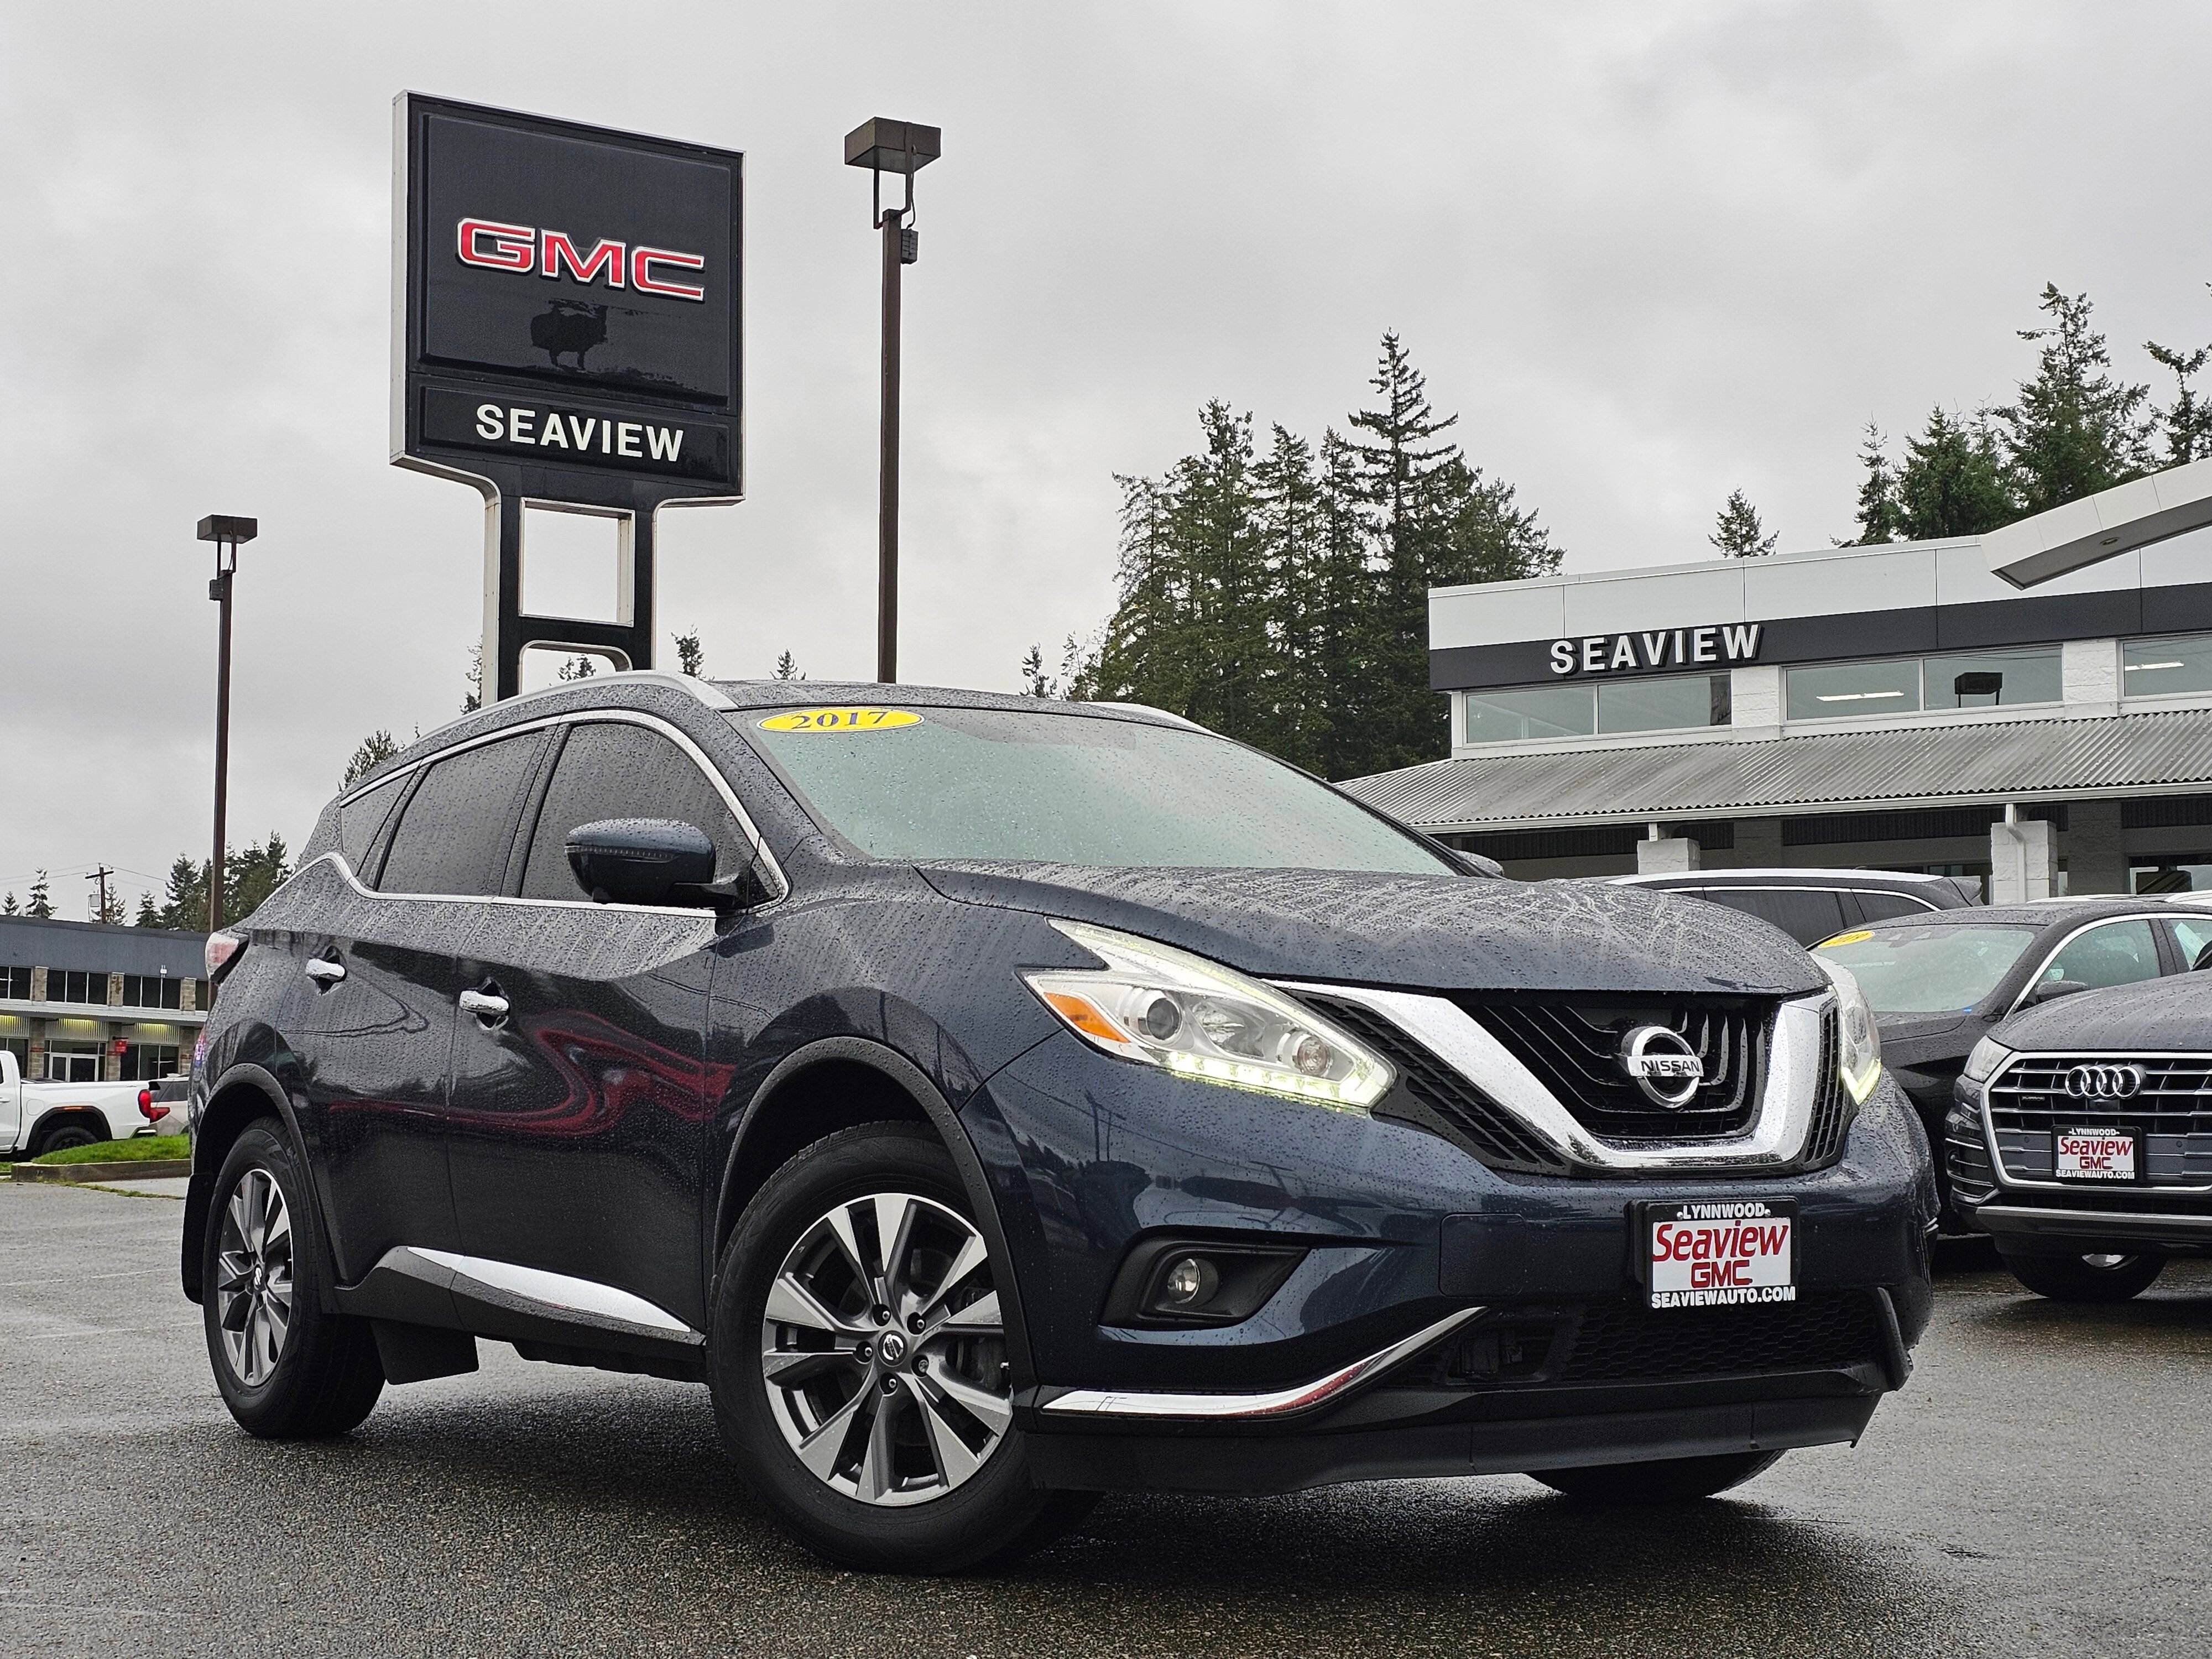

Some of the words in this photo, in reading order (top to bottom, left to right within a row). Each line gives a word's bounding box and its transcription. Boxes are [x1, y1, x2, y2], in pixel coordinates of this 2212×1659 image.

[457, 218, 704, 301] GMC
[476, 404, 684, 461] SEAVIEW
[1551, 624, 1759, 674] SEAVIEW
[791, 711, 888, 729] 2017
[1641, 1060, 1699, 1072] NISSAN
[2059, 1137, 2133, 1156] Seaview
[2080, 1156, 2113, 1169] GMC
[2056, 1170, 2135, 1180] SEAVIEWAUTO.COM
[1683, 1203, 1765, 1219] LYNNWOOD
[1653, 1220, 1789, 1261] Seaview
[1691, 1260, 1752, 1288] GMC
[1652, 1287, 1796, 1308] SEAVIEWAUTO.COM
